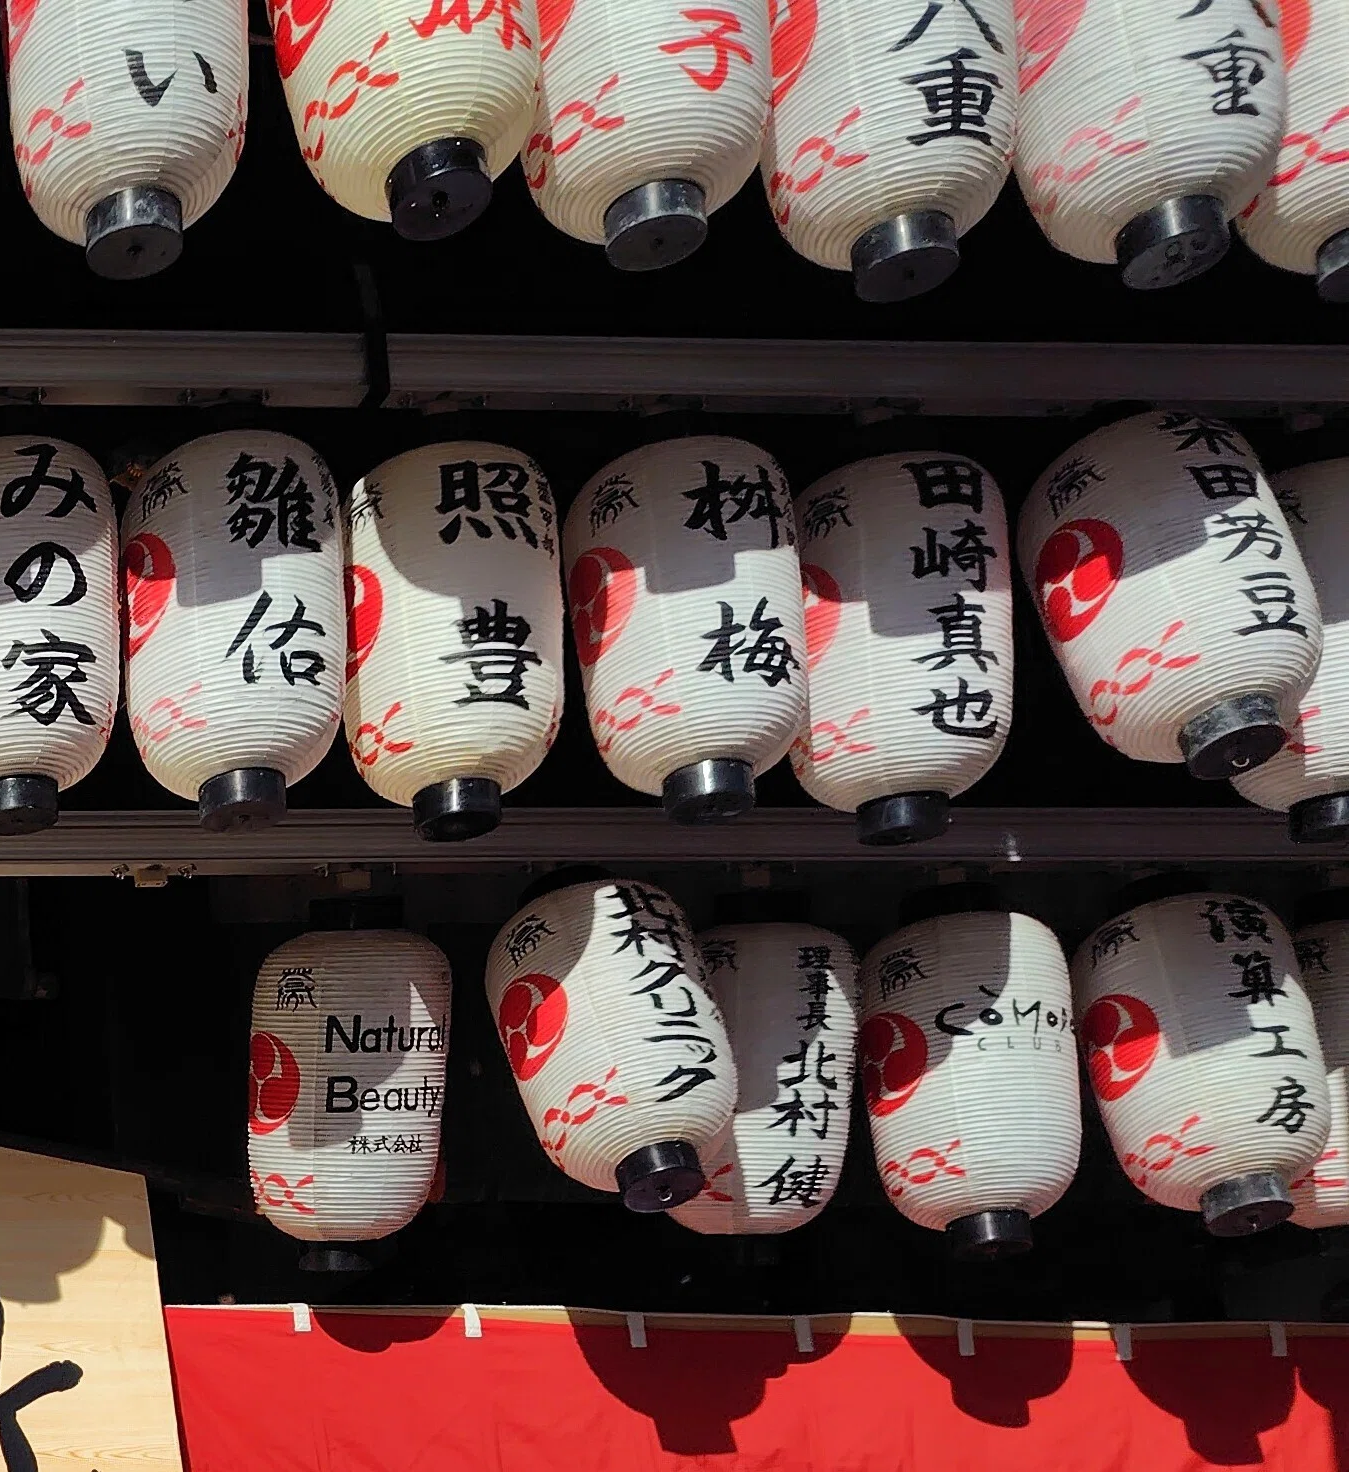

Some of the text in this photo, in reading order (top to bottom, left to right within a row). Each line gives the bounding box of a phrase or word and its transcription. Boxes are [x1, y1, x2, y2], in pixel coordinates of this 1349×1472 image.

[1, 442, 98, 727] みの家
[436, 460, 543, 712] 照豊
[902, 460, 1001, 740] 田崎真也
[324, 1013, 447, 1054] Natural
[606, 884, 718, 1104] 北村クリニック
[796, 945, 836, 1032] 理事長
[325, 1075, 441, 1118] Beauty
[348, 1134, 424, 1155] 株式会社
